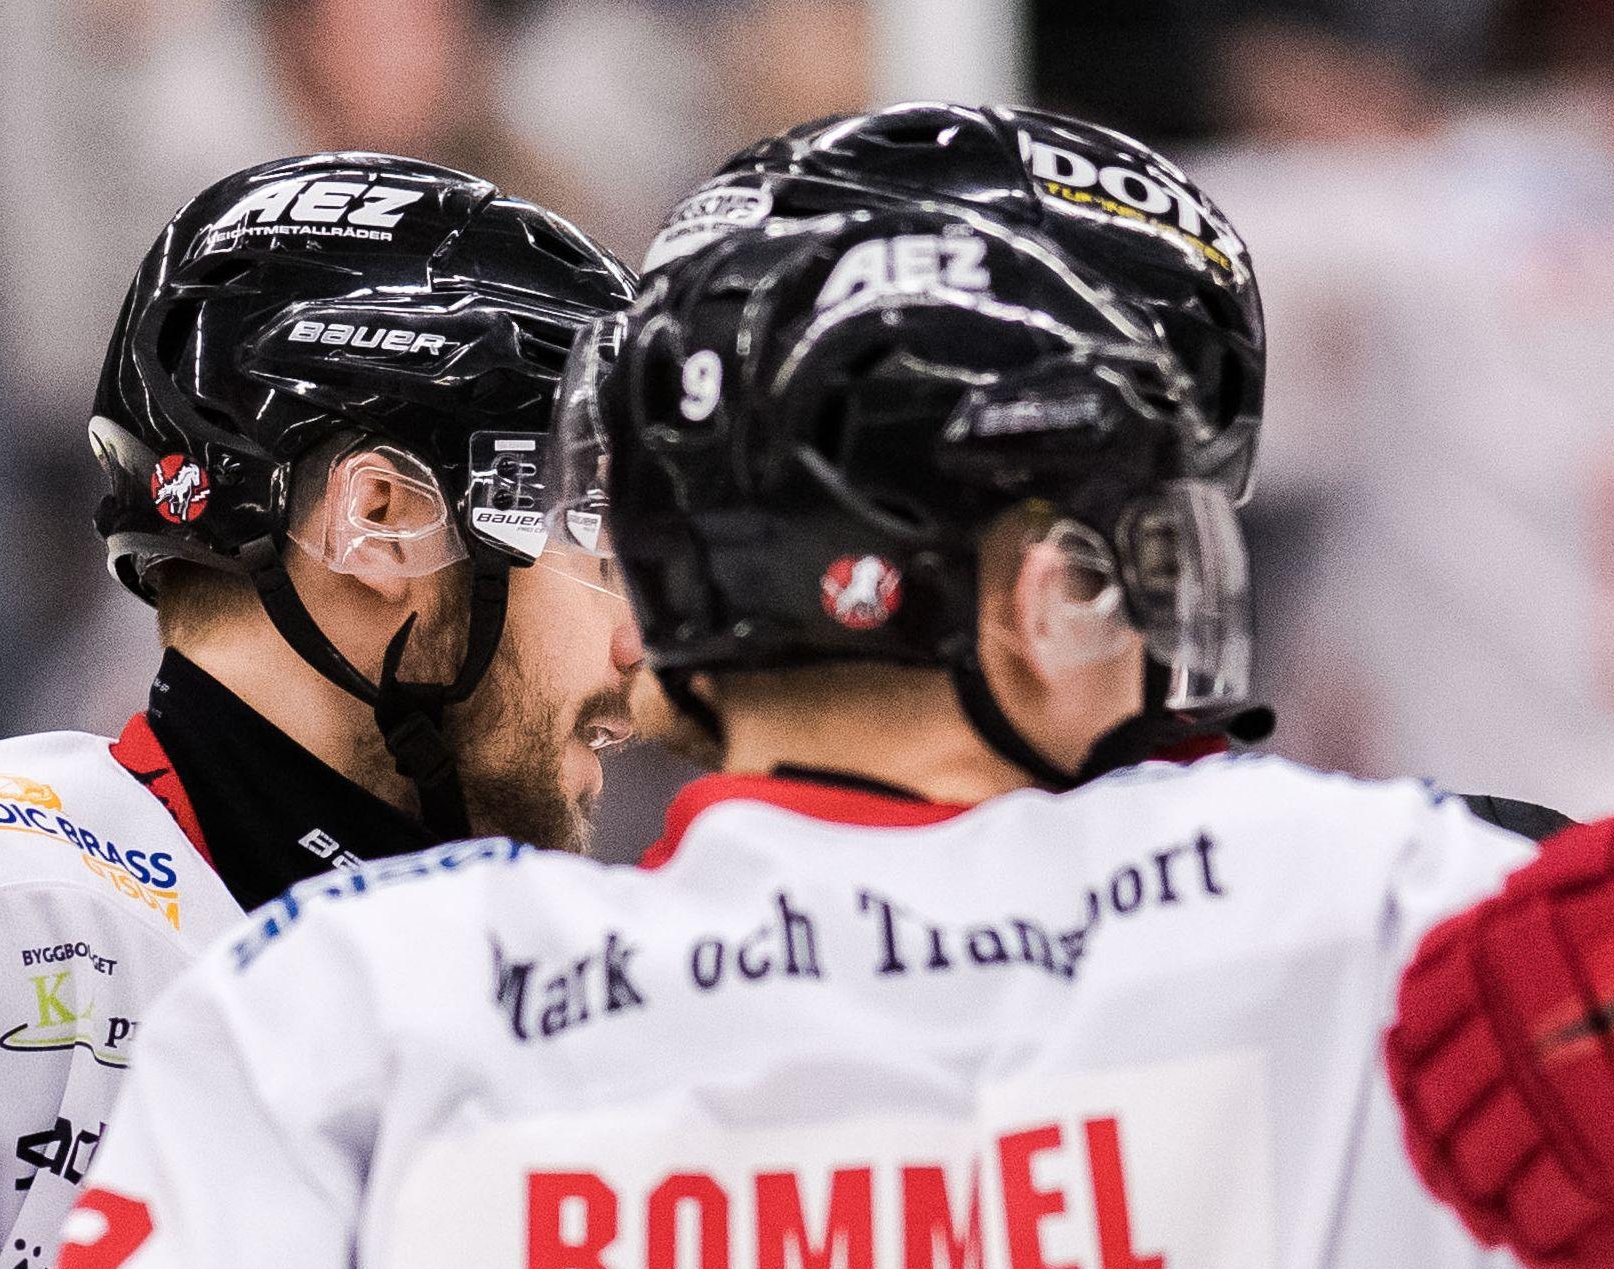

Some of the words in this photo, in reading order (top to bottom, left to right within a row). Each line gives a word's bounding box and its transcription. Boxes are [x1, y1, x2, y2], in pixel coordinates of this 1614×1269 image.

[207, 180, 426, 229] AEZ
[814, 233, 992, 309] AEZ
[680, 349, 724, 422] 9
[55, 815, 178, 889] BRASS
[689, 886, 824, 993] och
